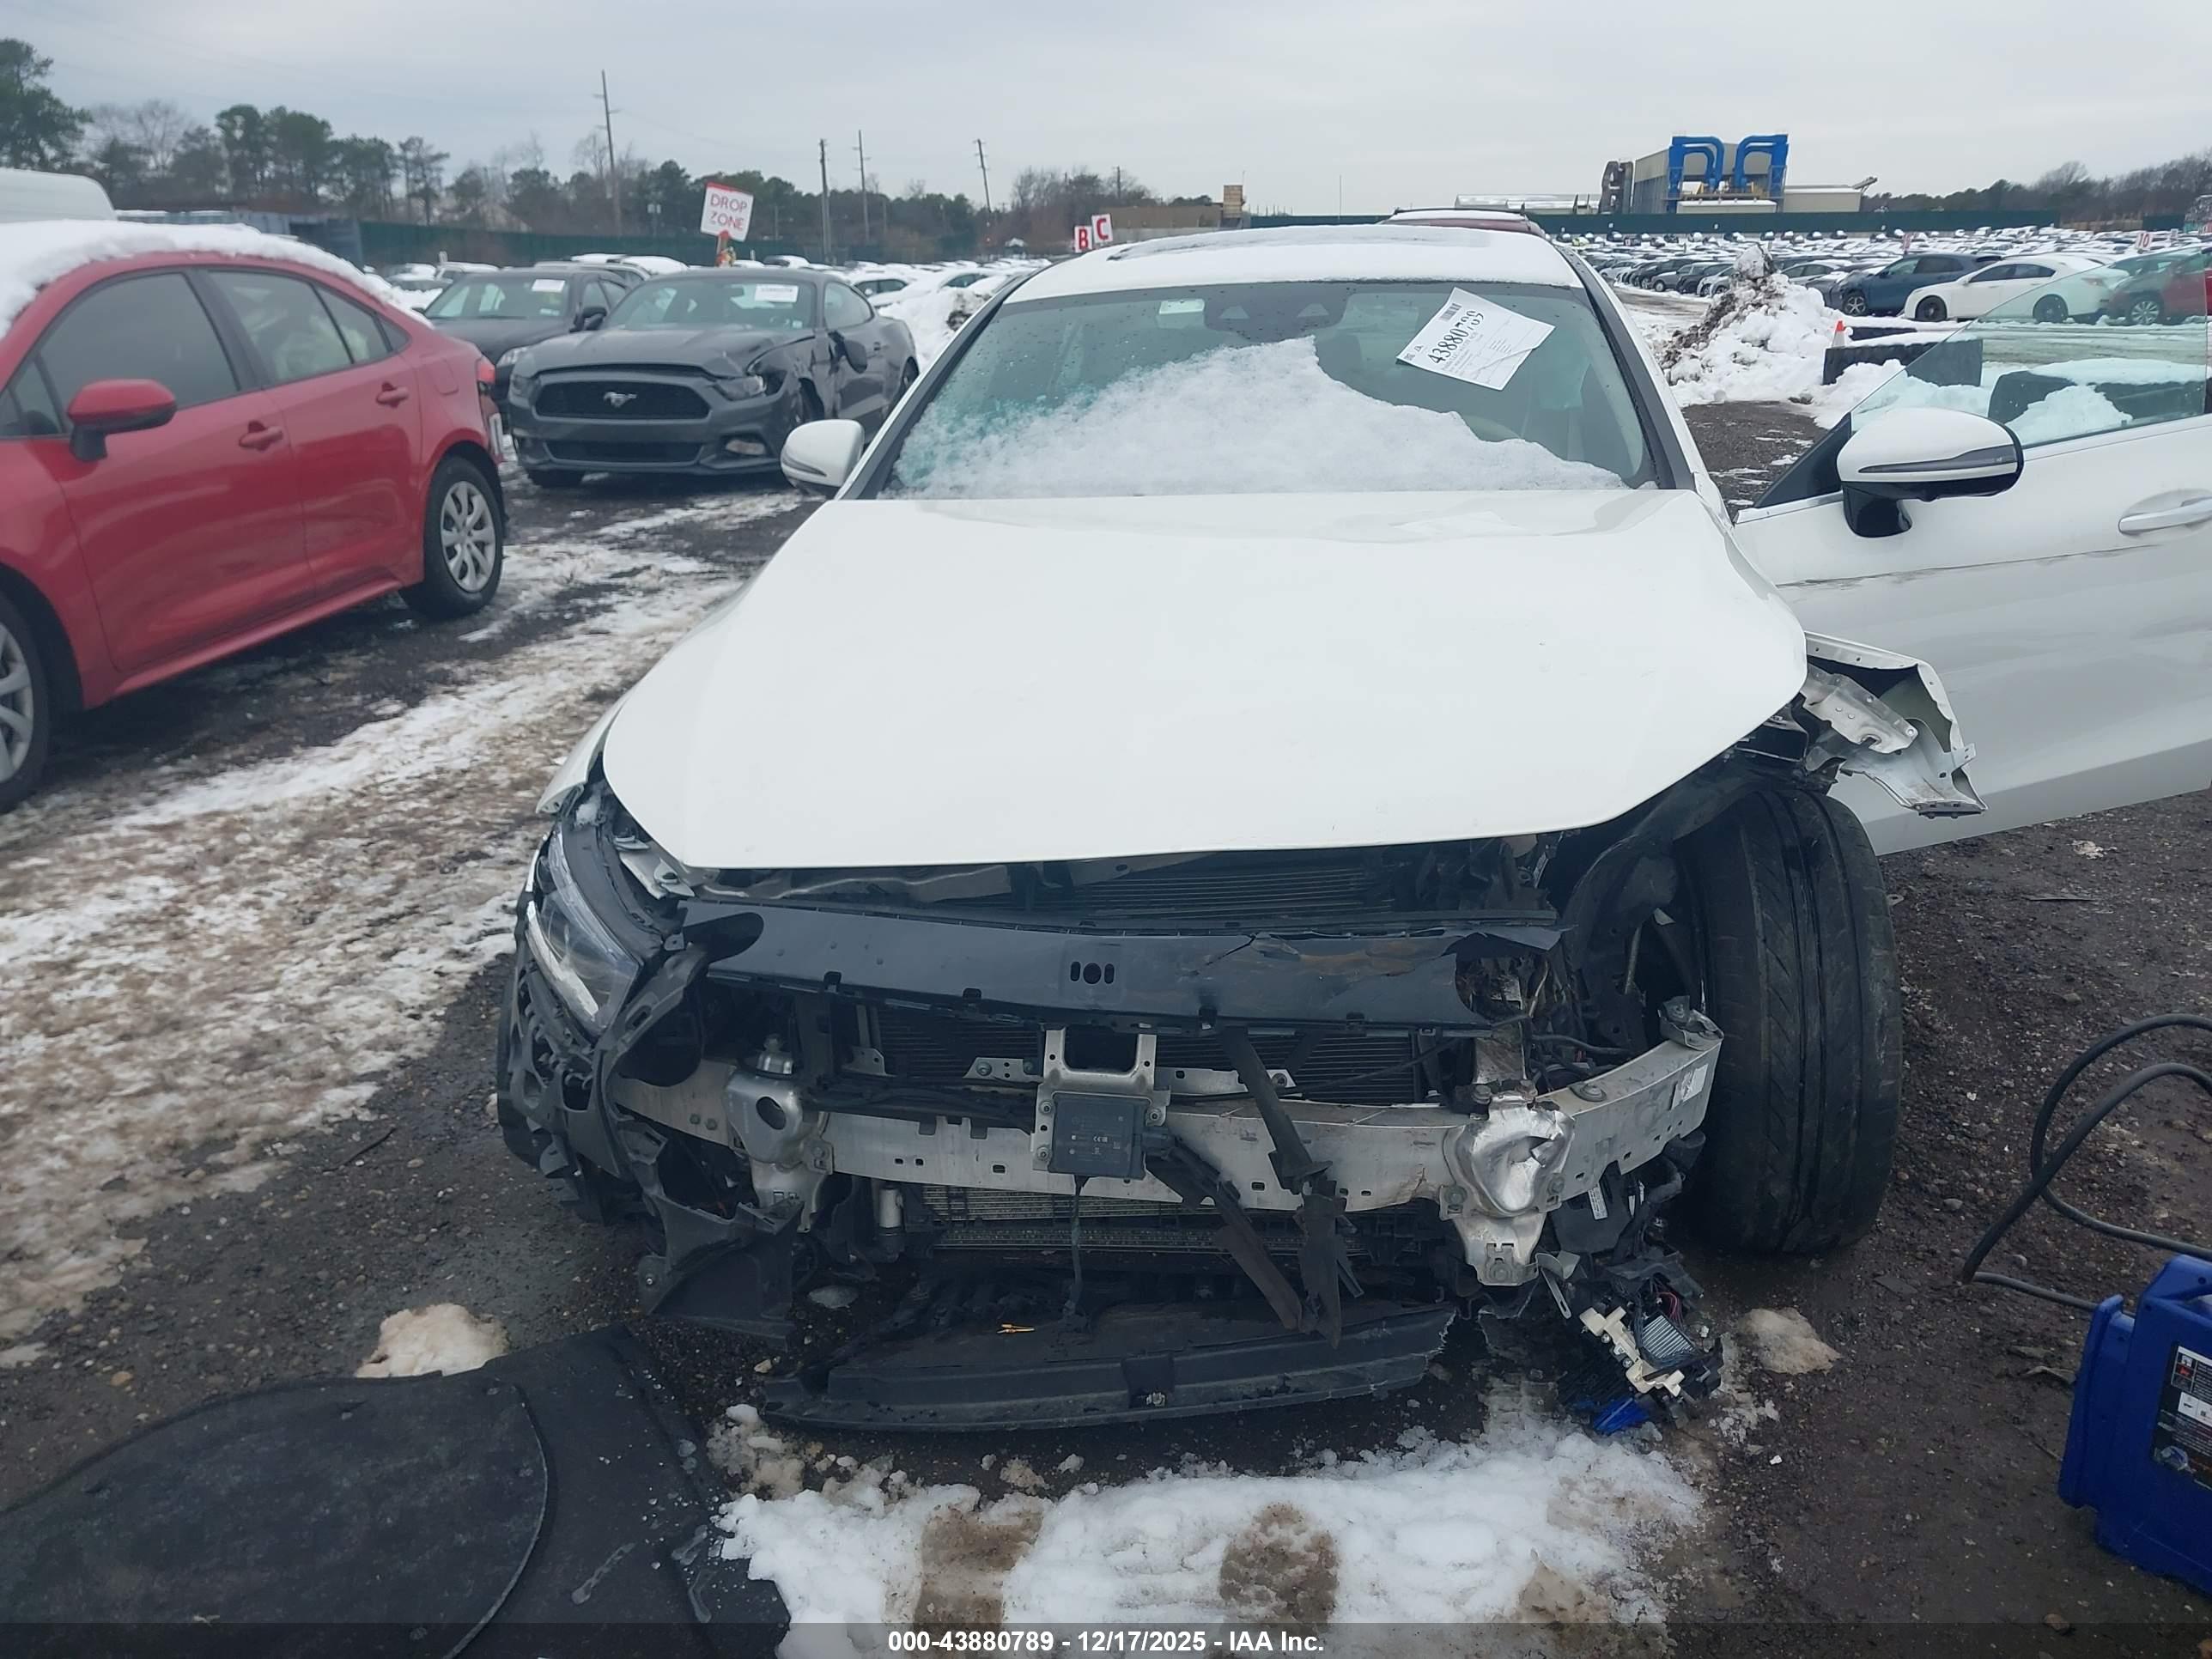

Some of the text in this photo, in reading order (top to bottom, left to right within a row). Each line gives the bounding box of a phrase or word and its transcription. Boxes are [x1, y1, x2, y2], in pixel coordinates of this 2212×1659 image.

[710, 193, 748, 212] DROP
[710, 211, 745, 230] ZONE
[1097, 218, 1109, 240] C
[1079, 228, 1089, 250] B
[2138, 233, 2150, 247] 10
